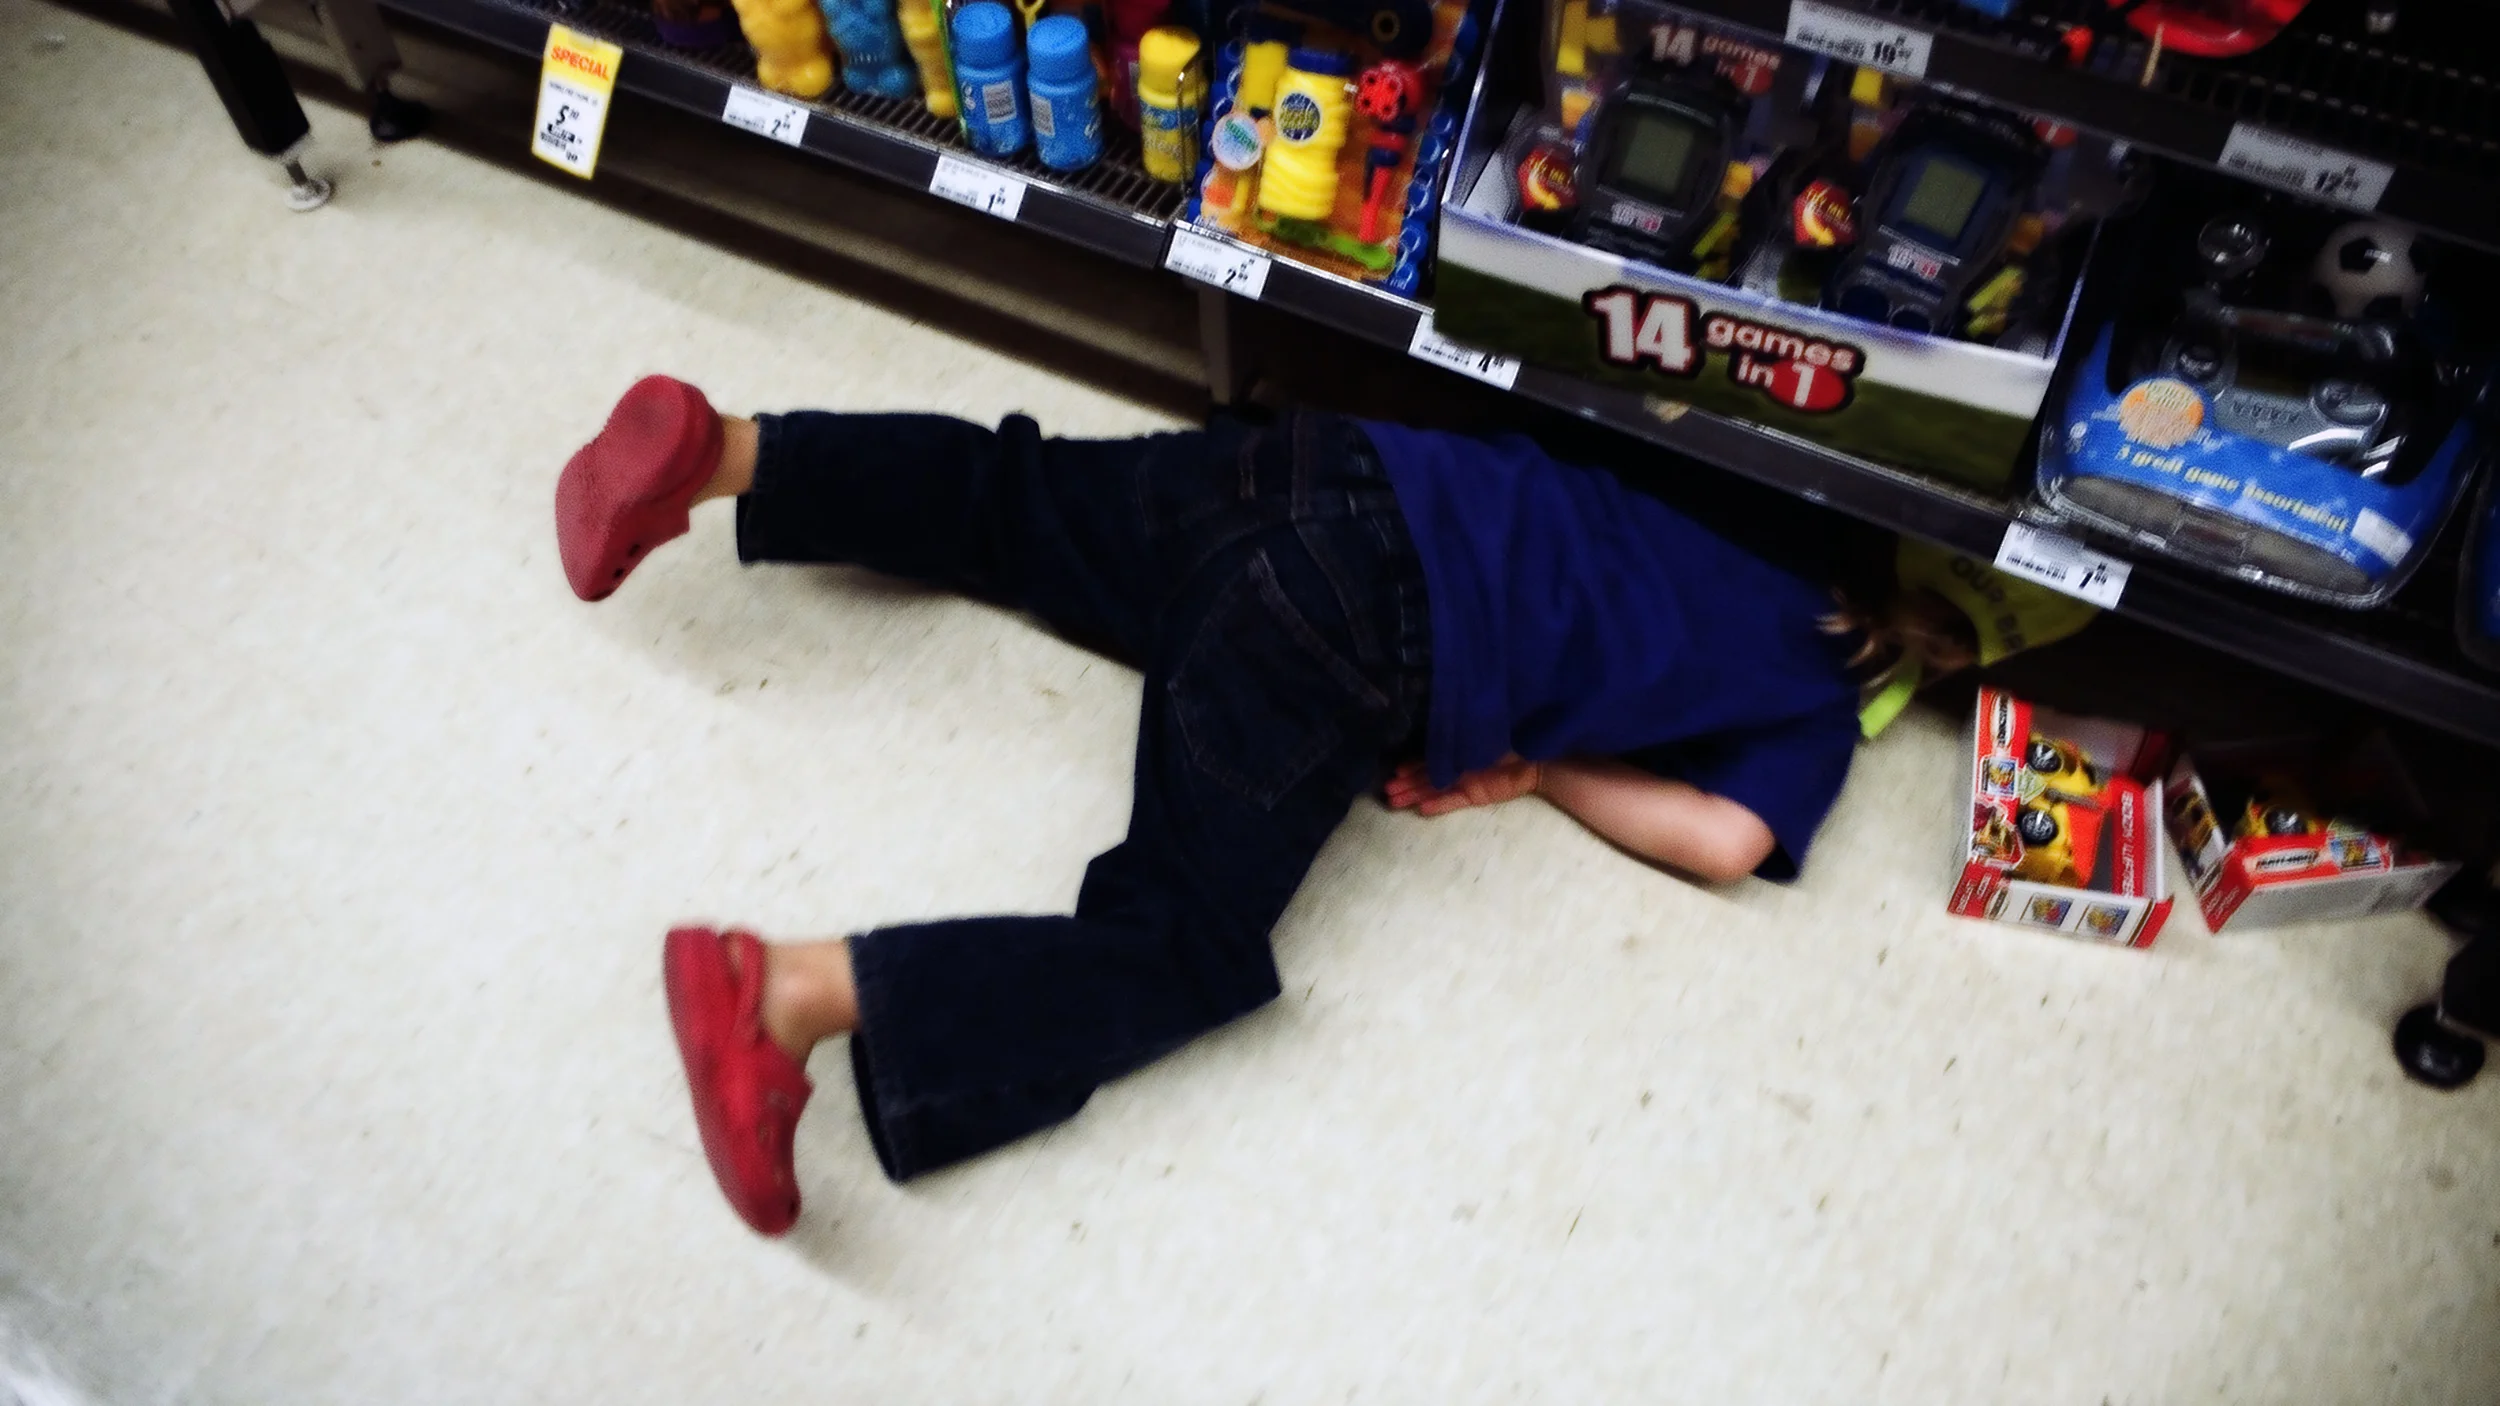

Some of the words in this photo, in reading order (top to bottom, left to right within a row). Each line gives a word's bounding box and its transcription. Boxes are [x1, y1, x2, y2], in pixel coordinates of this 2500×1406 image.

[550, 44, 610, 80] SPECIAL
[1650, 23, 1695, 66] 14
[1594, 292, 1692, 371] 14
[1706, 317, 1855, 371] games
[1737, 352, 1774, 388] in
[1792, 361, 1817, 407] 1
[2132, 450, 2185, 476] great
[2184, 466, 2240, 493] game
